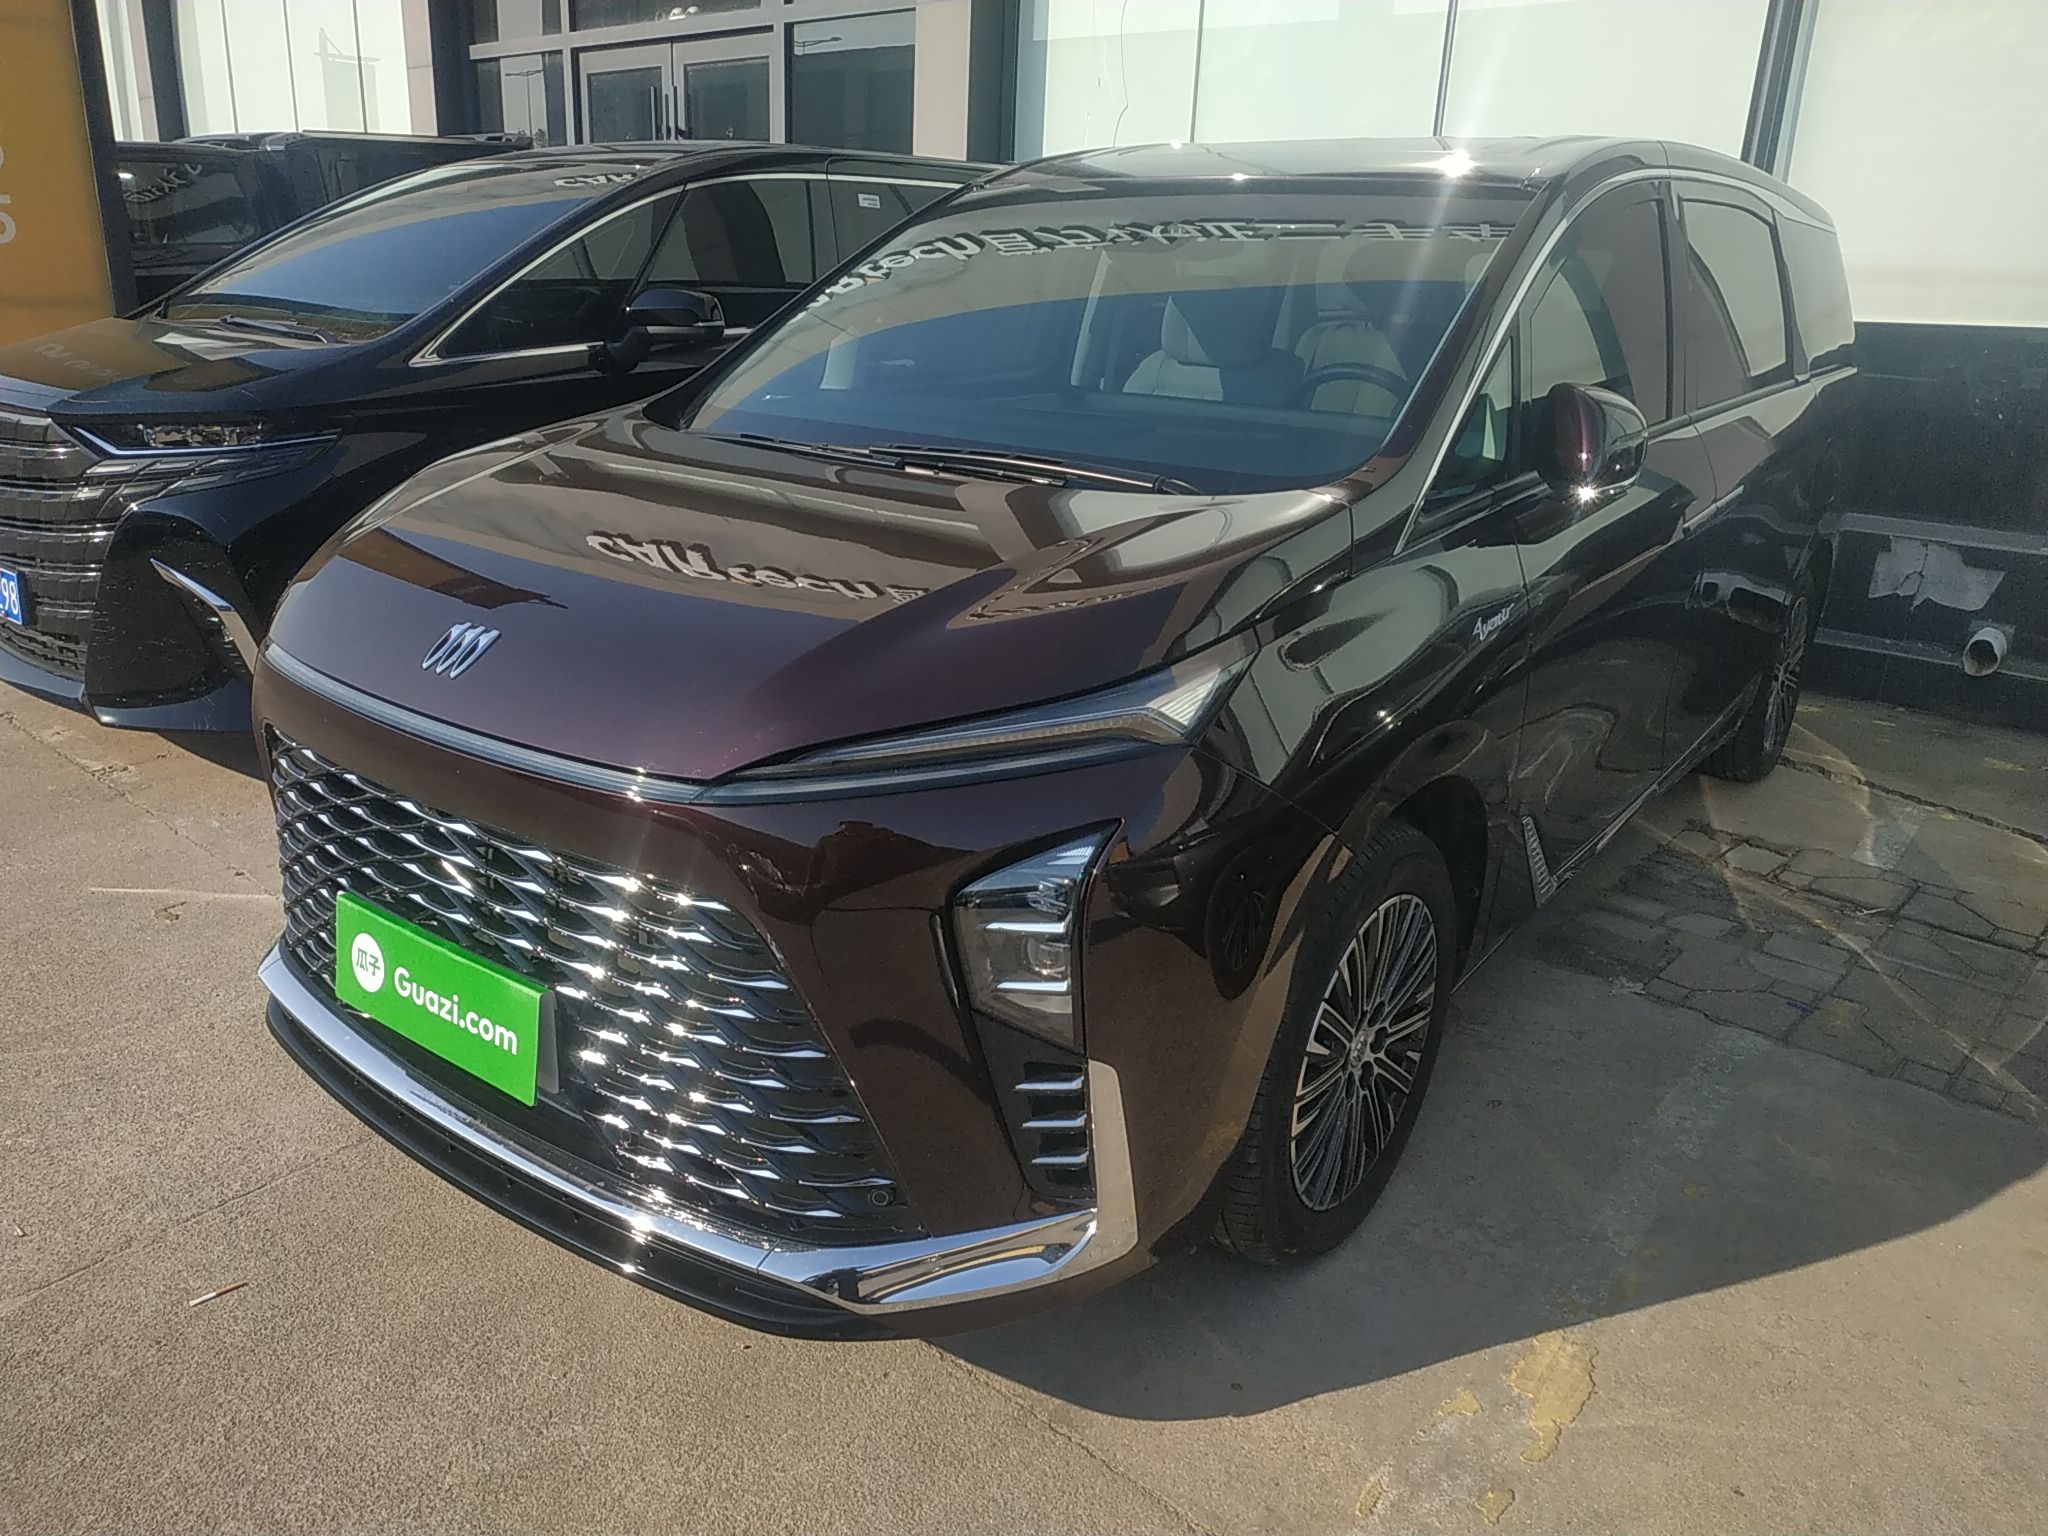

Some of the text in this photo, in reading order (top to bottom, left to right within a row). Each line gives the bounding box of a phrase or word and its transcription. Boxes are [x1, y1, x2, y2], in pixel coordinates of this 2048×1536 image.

[0, 577, 19, 615] 98
[355, 946, 381, 977] 瓜子
[394, 966, 518, 1056] Guazi.com
